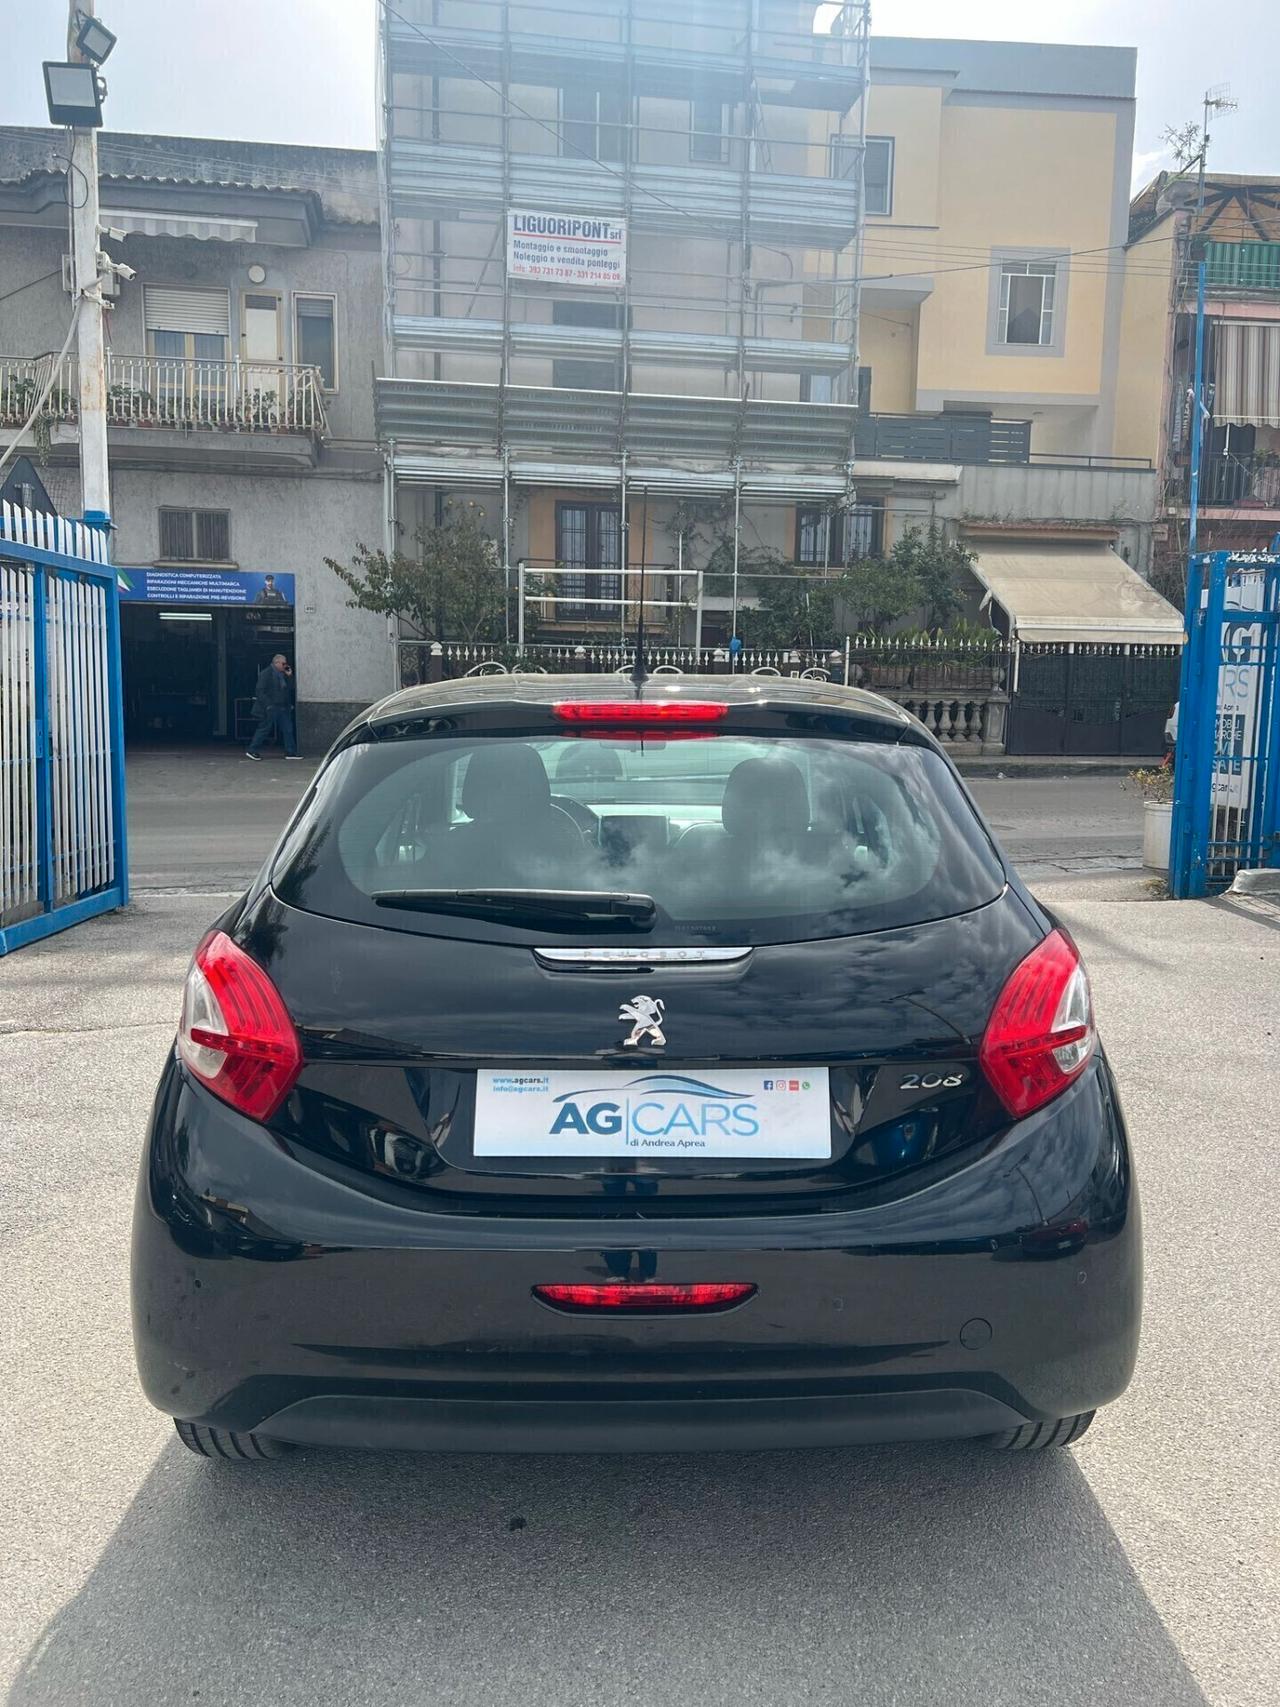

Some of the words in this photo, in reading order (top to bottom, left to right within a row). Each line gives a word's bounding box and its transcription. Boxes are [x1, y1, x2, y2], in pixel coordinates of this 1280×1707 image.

[513, 214, 610, 239] LIGUORIPONT
[610, 229, 622, 240] srl
[513, 240, 555, 253] Montaggio
[563, 246, 608, 258] smontaggio
[513, 251, 548, 264] Noleggio
[557, 255, 585, 266] vendita
[587, 260, 621, 270] ponteggi
[492, 1076, 549, 1085] www.agcars.it
[493, 1085, 549, 1093] info@agcars.it
[899, 1073, 963, 1090] 208
[549, 1102, 622, 1135] AG
[632, 1103, 760, 1137] CARS
[630, 1139, 639, 1147] di
[641, 1138, 675, 1147] Andrea
[677, 1139, 705, 1148] Aprea
